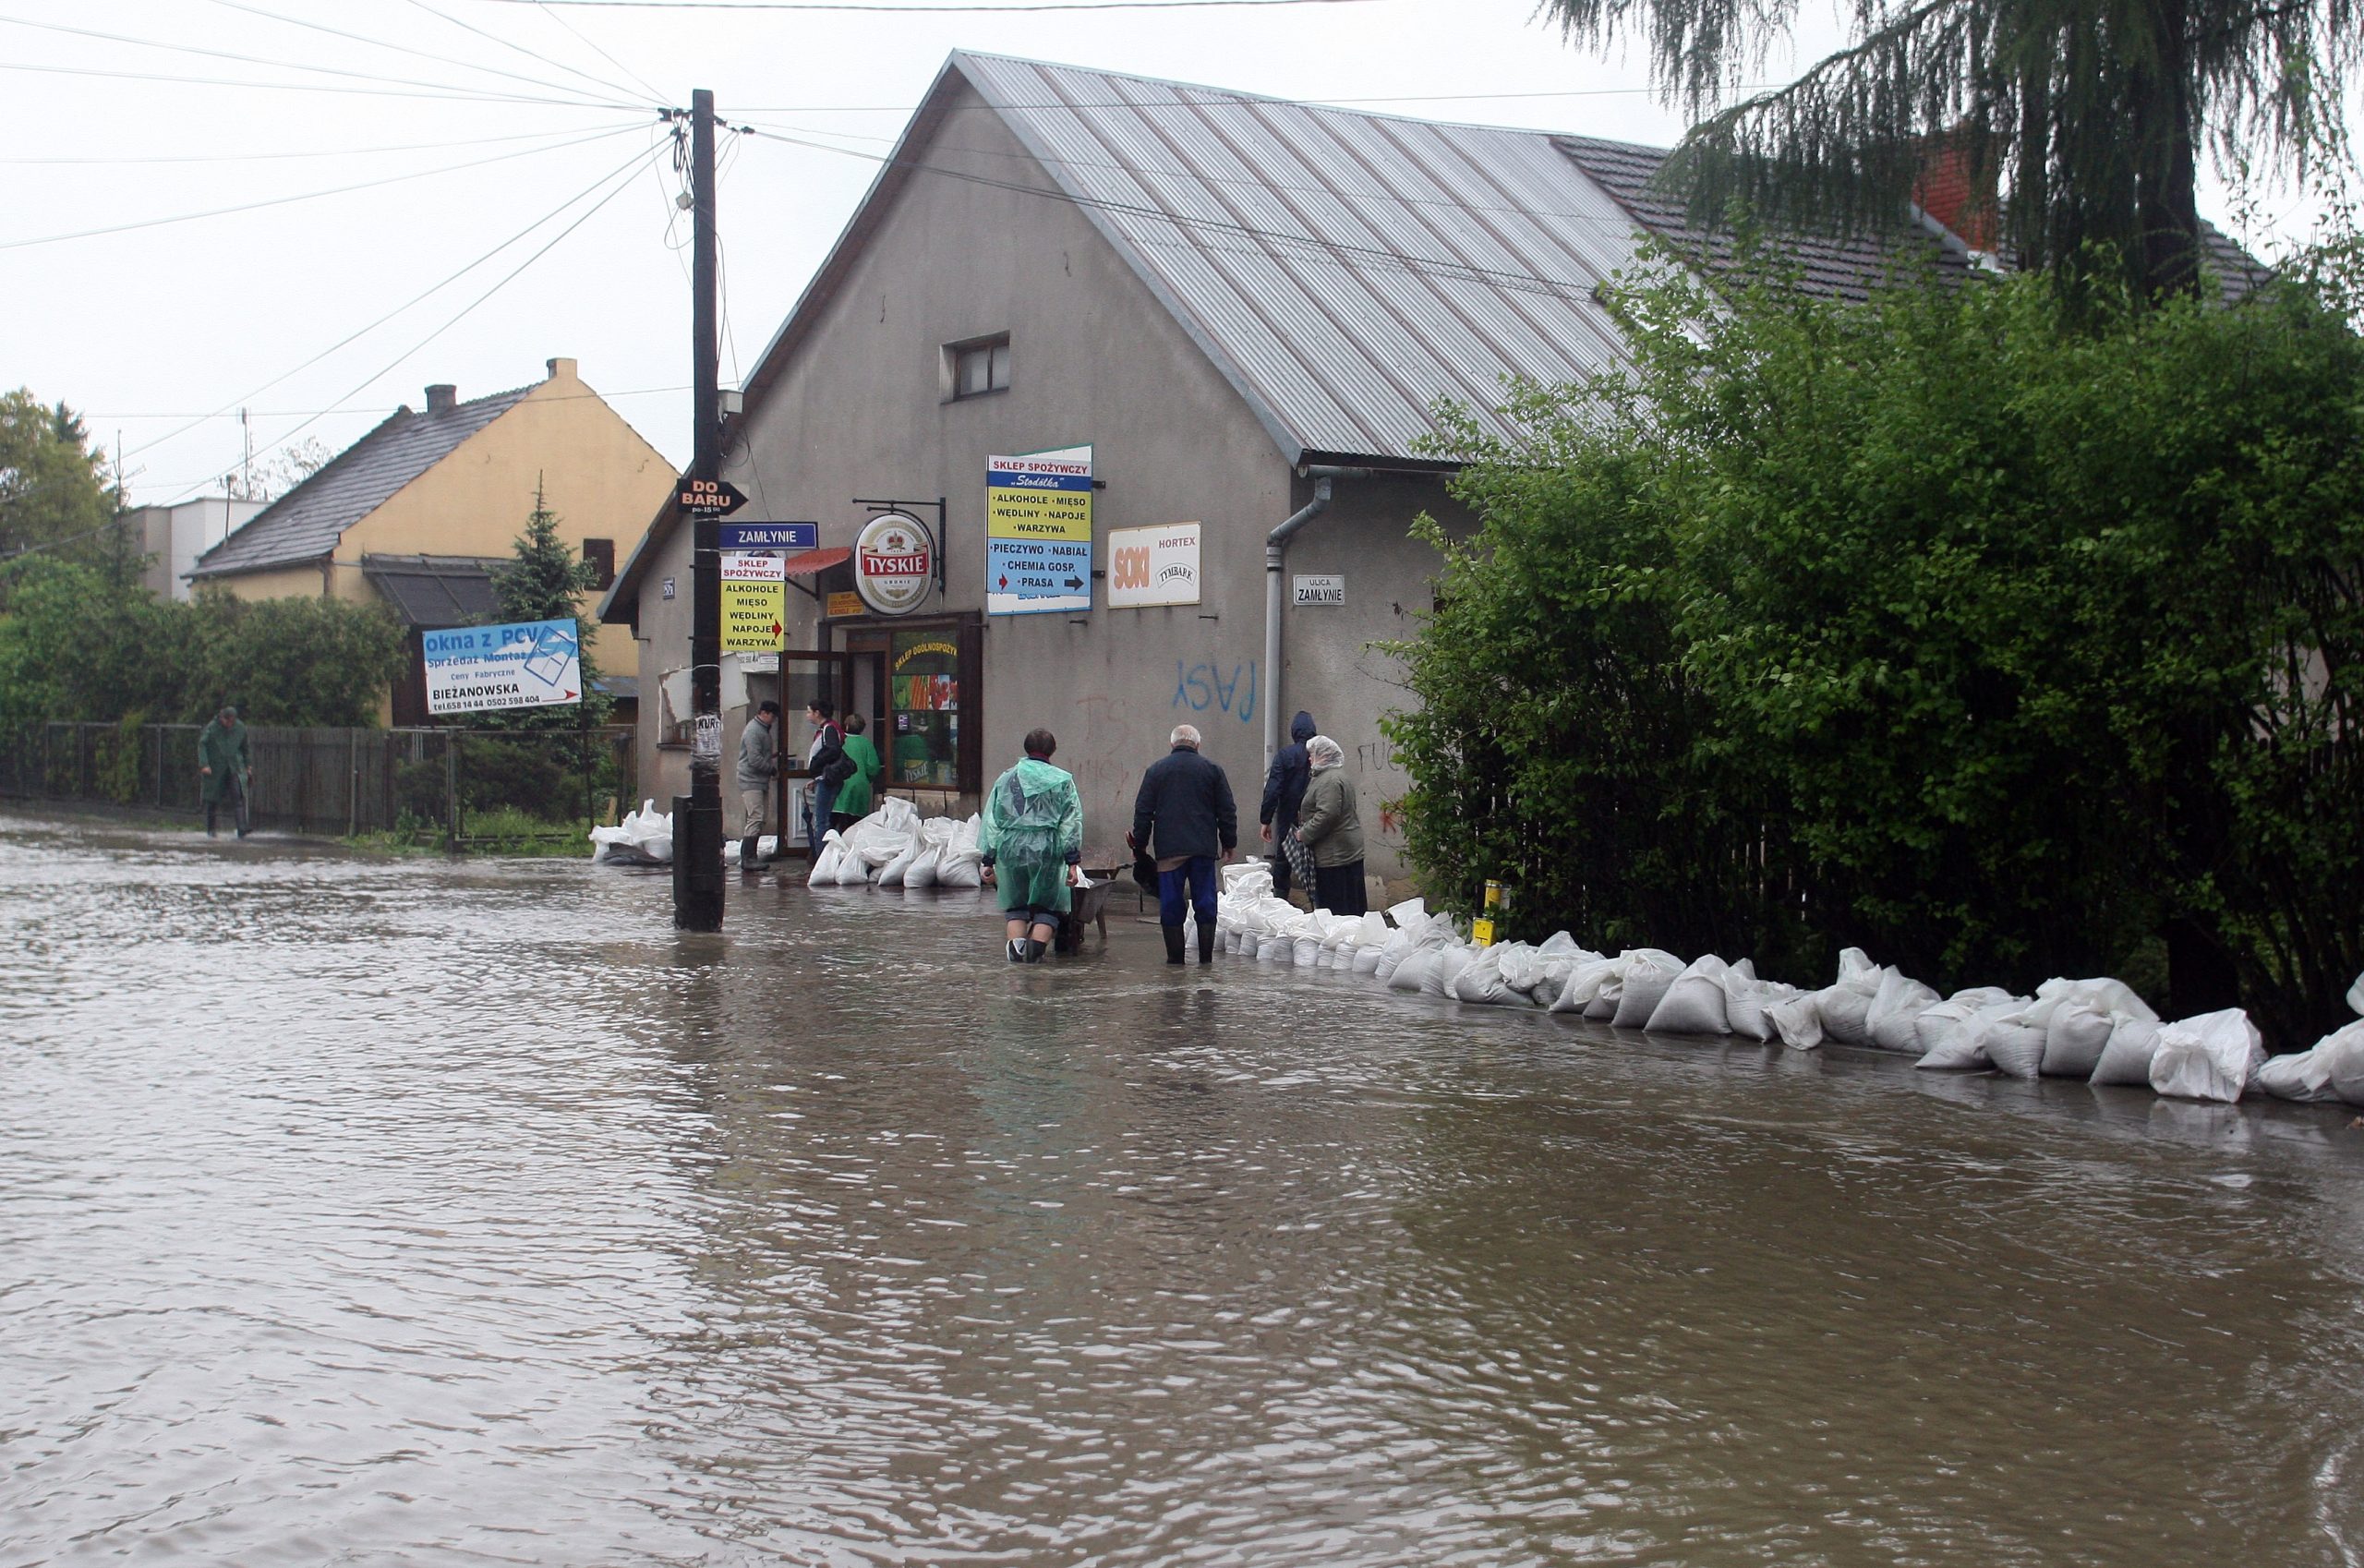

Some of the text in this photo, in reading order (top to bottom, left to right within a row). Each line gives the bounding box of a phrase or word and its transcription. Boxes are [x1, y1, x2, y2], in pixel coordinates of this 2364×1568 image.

[993, 461, 1088, 474] SKLEP SPOŻYWCZY
[693, 480, 718, 493] DO
[681, 492, 730, 506] BARU
[996, 494, 1086, 508] ALKOHOLE MIĘSO
[996, 509, 1086, 520] WĘDLINY NAPOJE
[1017, 524, 1066, 533] WARZYWA
[738, 530, 797, 543] ZAMŁYNIE
[1158, 537, 1196, 549] HORTEX
[994, 544, 1088, 556] PIECZYWO NABIAŁ
[738, 560, 768, 568] SKLEP
[866, 556, 923, 573] TYSKIE
[1007, 561, 1076, 573] CHEMIA GOSP.
[1114, 546, 1151, 589] SOKI
[723, 568, 782, 578] SPOŻYWCZY
[1160, 566, 1193, 582] TYMBARK
[1021, 577, 1054, 587] PRASA
[725, 585, 778, 594] ALKOHOLE
[1297, 589, 1342, 601] ZAMŁYNIE
[736, 598, 768, 609] MIĘSO
[730, 611, 775, 621] WĘDLINY
[732, 625, 772, 633] NAPOJE
[426, 627, 538, 652] okna z PCV
[727, 638, 778, 646] WARZYWA
[895, 649, 912, 671] SKLEP
[451, 669, 516, 681] Ceny Fabryczne
[433, 683, 520, 700] BIEŻANOWSKA
[487, 698, 507, 706] 0502
[525, 695, 540, 704] 404
